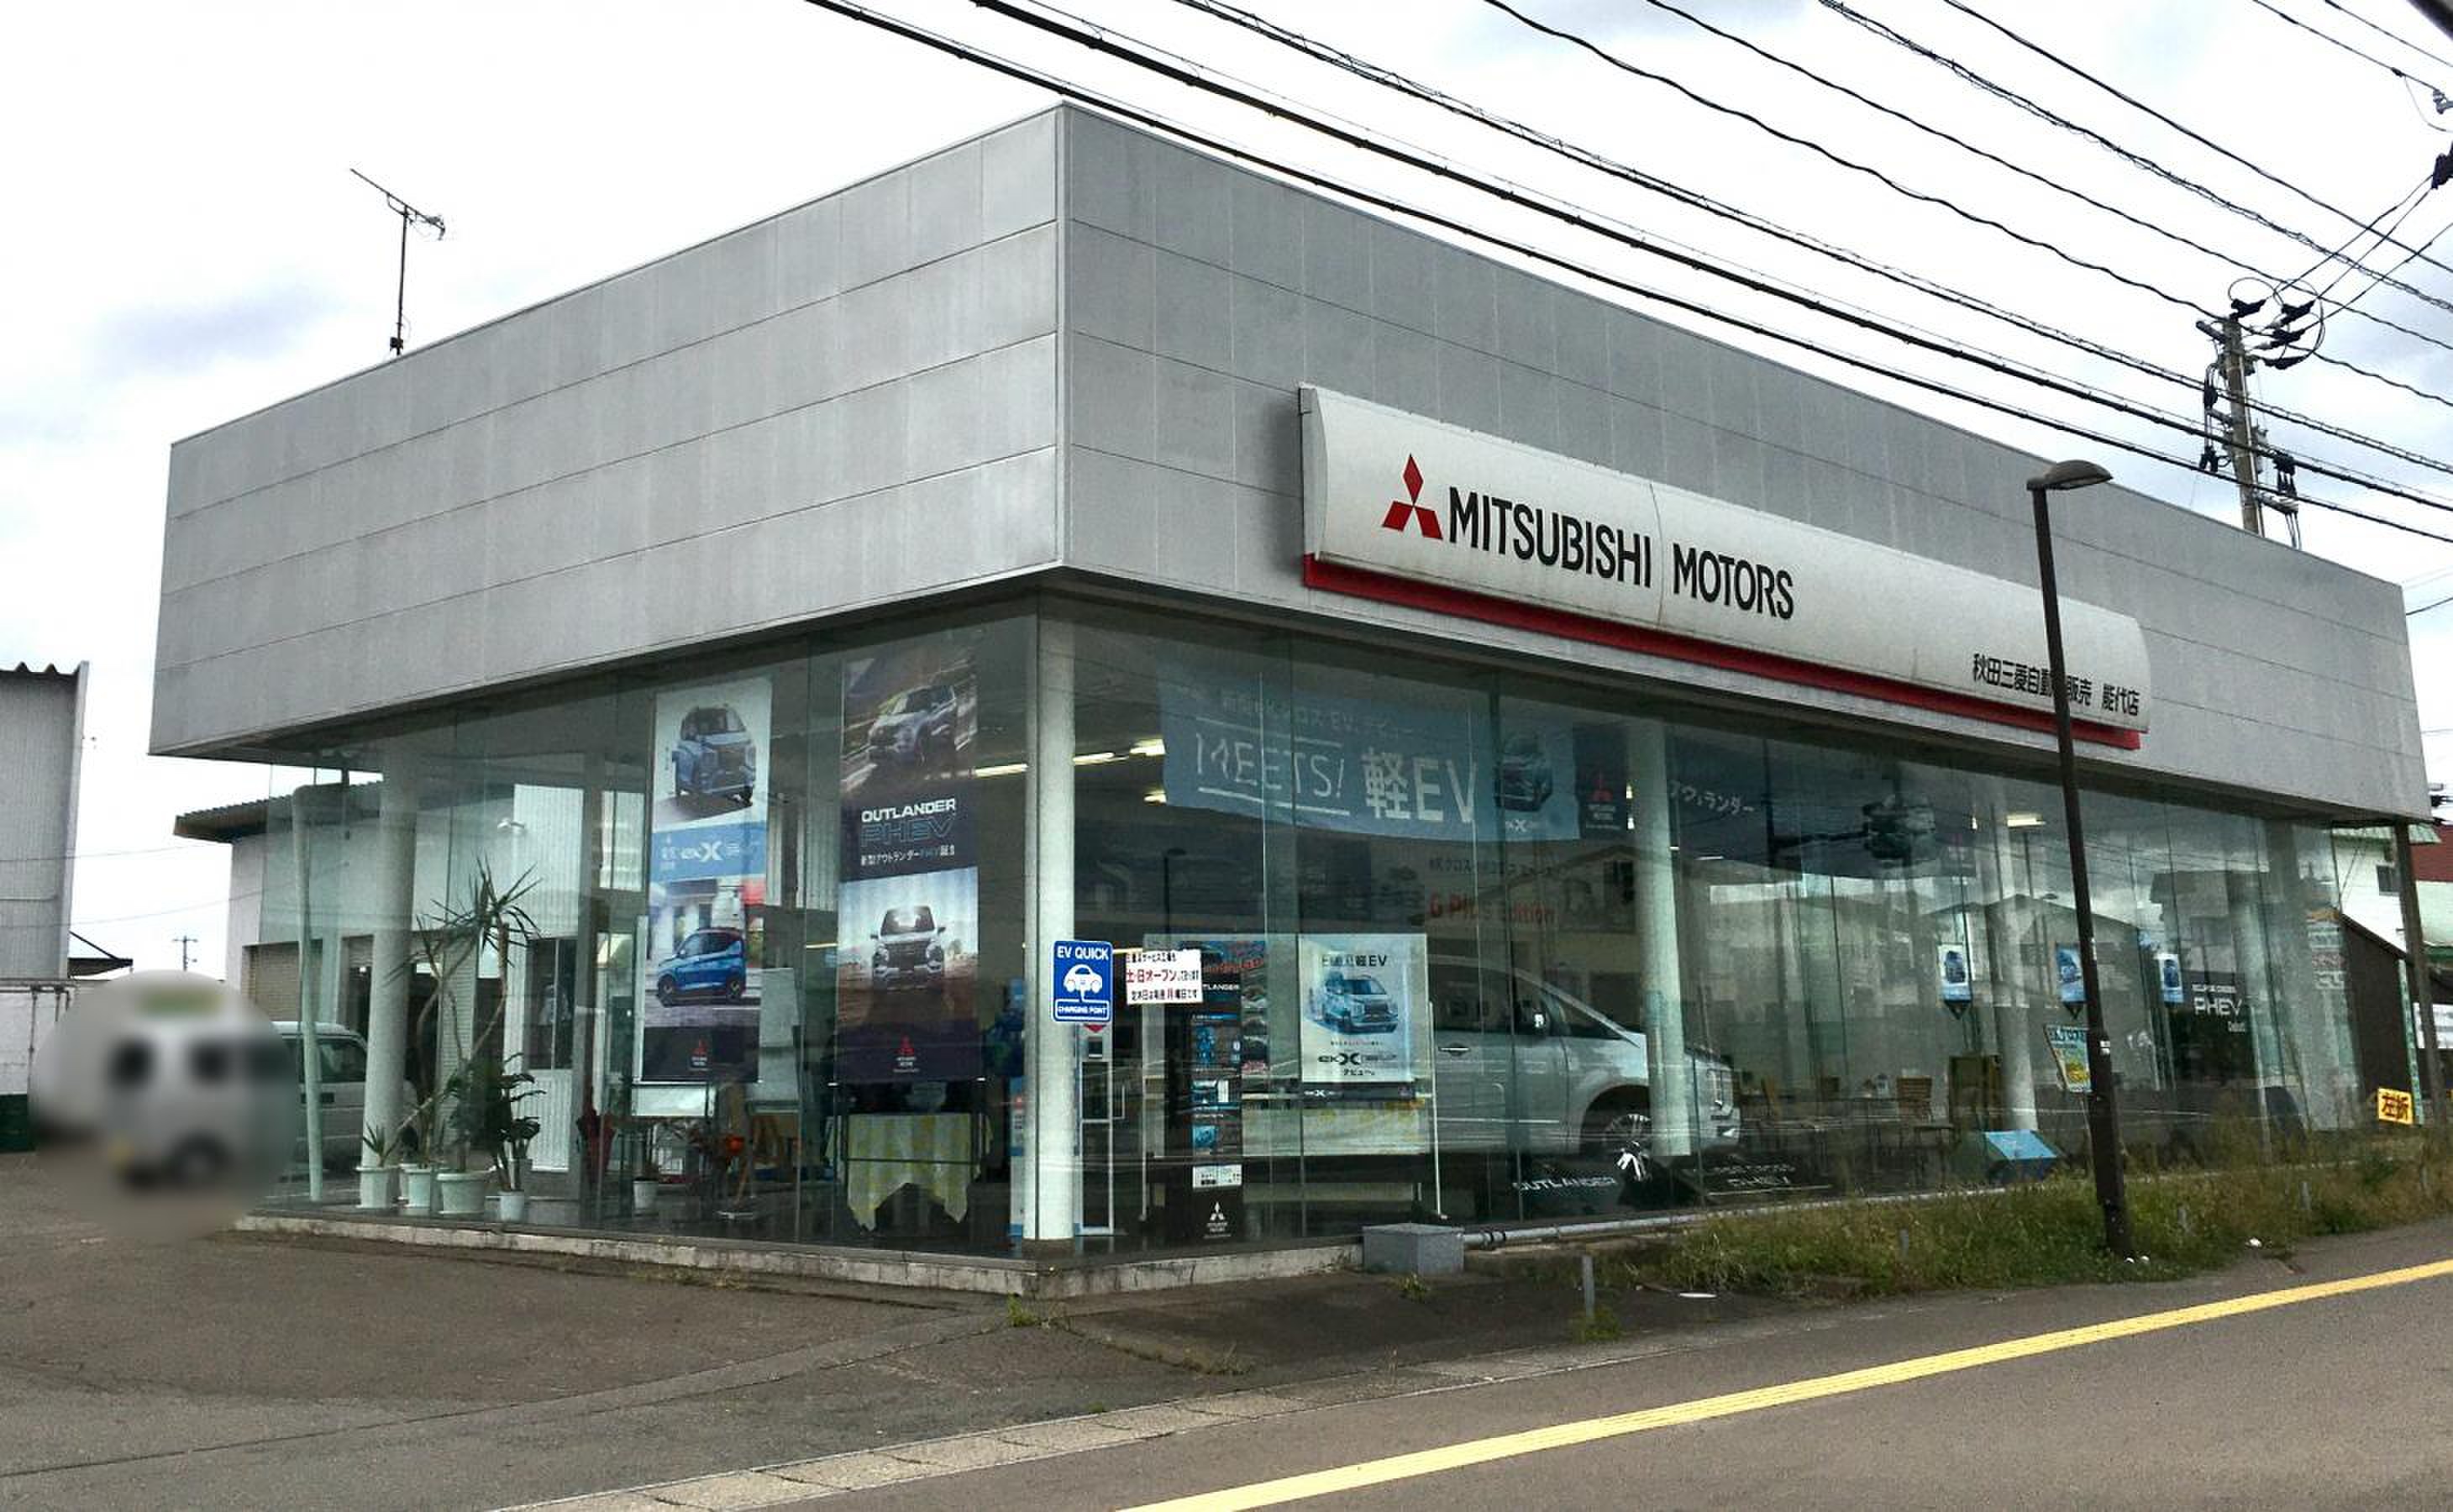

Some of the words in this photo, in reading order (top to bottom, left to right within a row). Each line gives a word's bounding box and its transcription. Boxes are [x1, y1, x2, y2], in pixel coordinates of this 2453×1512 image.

[1449, 486, 1652, 588] MITSUBISHI
[1673, 543, 1794, 620] MOTORS
[1973, 653, 2093, 706] 秋田三菱自動販売
[1196, 732, 1345, 799] MEETS!
[1361, 746, 1479, 824] 軽EV
[861, 798, 956, 823] OUTLANDER
[861, 815, 956, 848] PHEV
[1057, 945, 1073, 958] EV
[1074, 946, 1109, 960] QUICK
[2194, 998, 2243, 1016] PHEV
